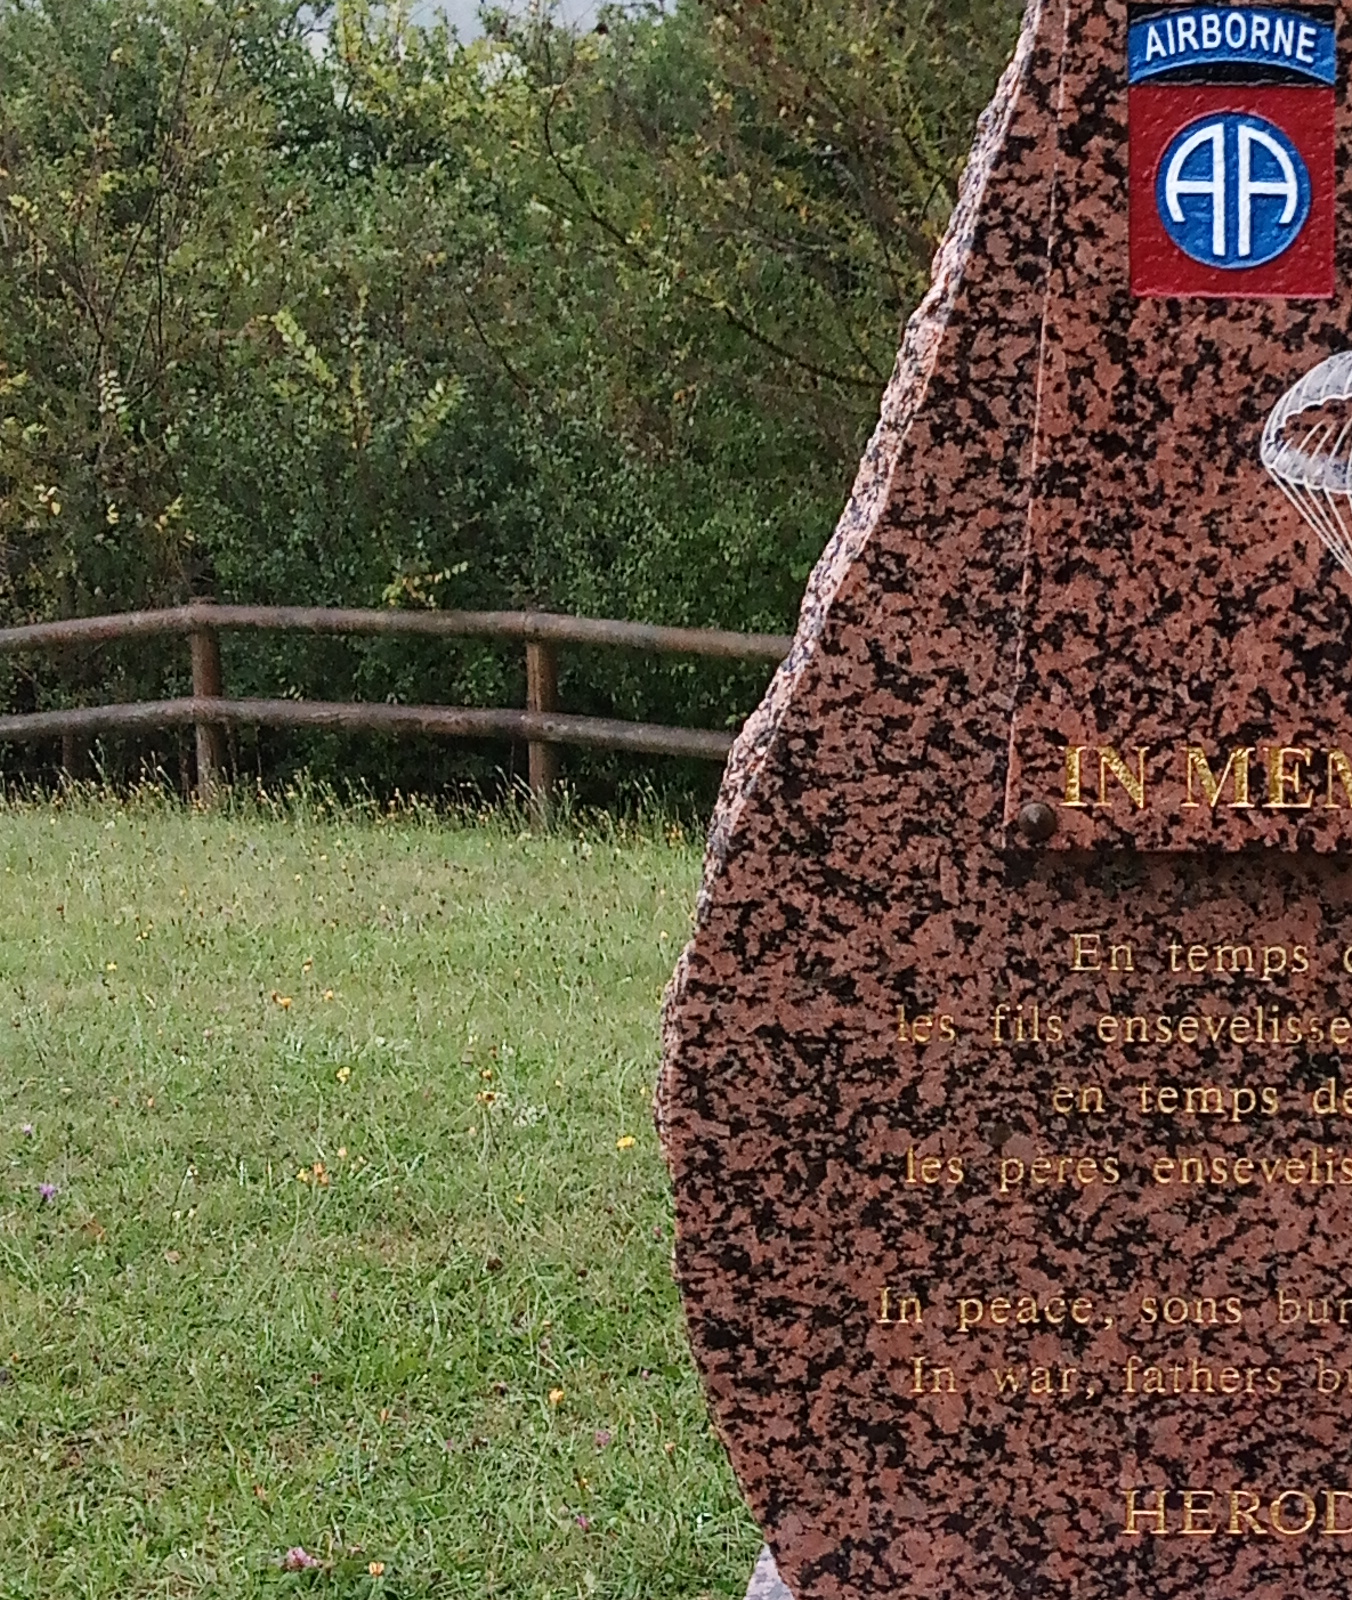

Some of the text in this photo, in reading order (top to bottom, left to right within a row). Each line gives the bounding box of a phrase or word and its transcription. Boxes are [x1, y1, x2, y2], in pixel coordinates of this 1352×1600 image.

[1145, 12, 1317, 63] AIRBORNE
[1165, 123, 1296, 257] AA
[1058, 744, 1147, 809] IN
[1069, 932, 1135, 973] En
[1168, 941, 1310, 981] temps
[896, 1004, 957, 1044] les
[989, 1004, 1064, 1044] fils
[1050, 1084, 1106, 1115] en
[1137, 1081, 1280, 1123] temps
[905, 1145, 965, 1185] les
[875, 1286, 924, 1326] In
[955, 1293, 1115, 1333] peace,
[1138, 1294, 1244, 1326] sons
[908, 1355, 958, 1395] In
[992, 1365, 1097, 1400] war,
[1120, 1355, 1284, 1395] fathers
